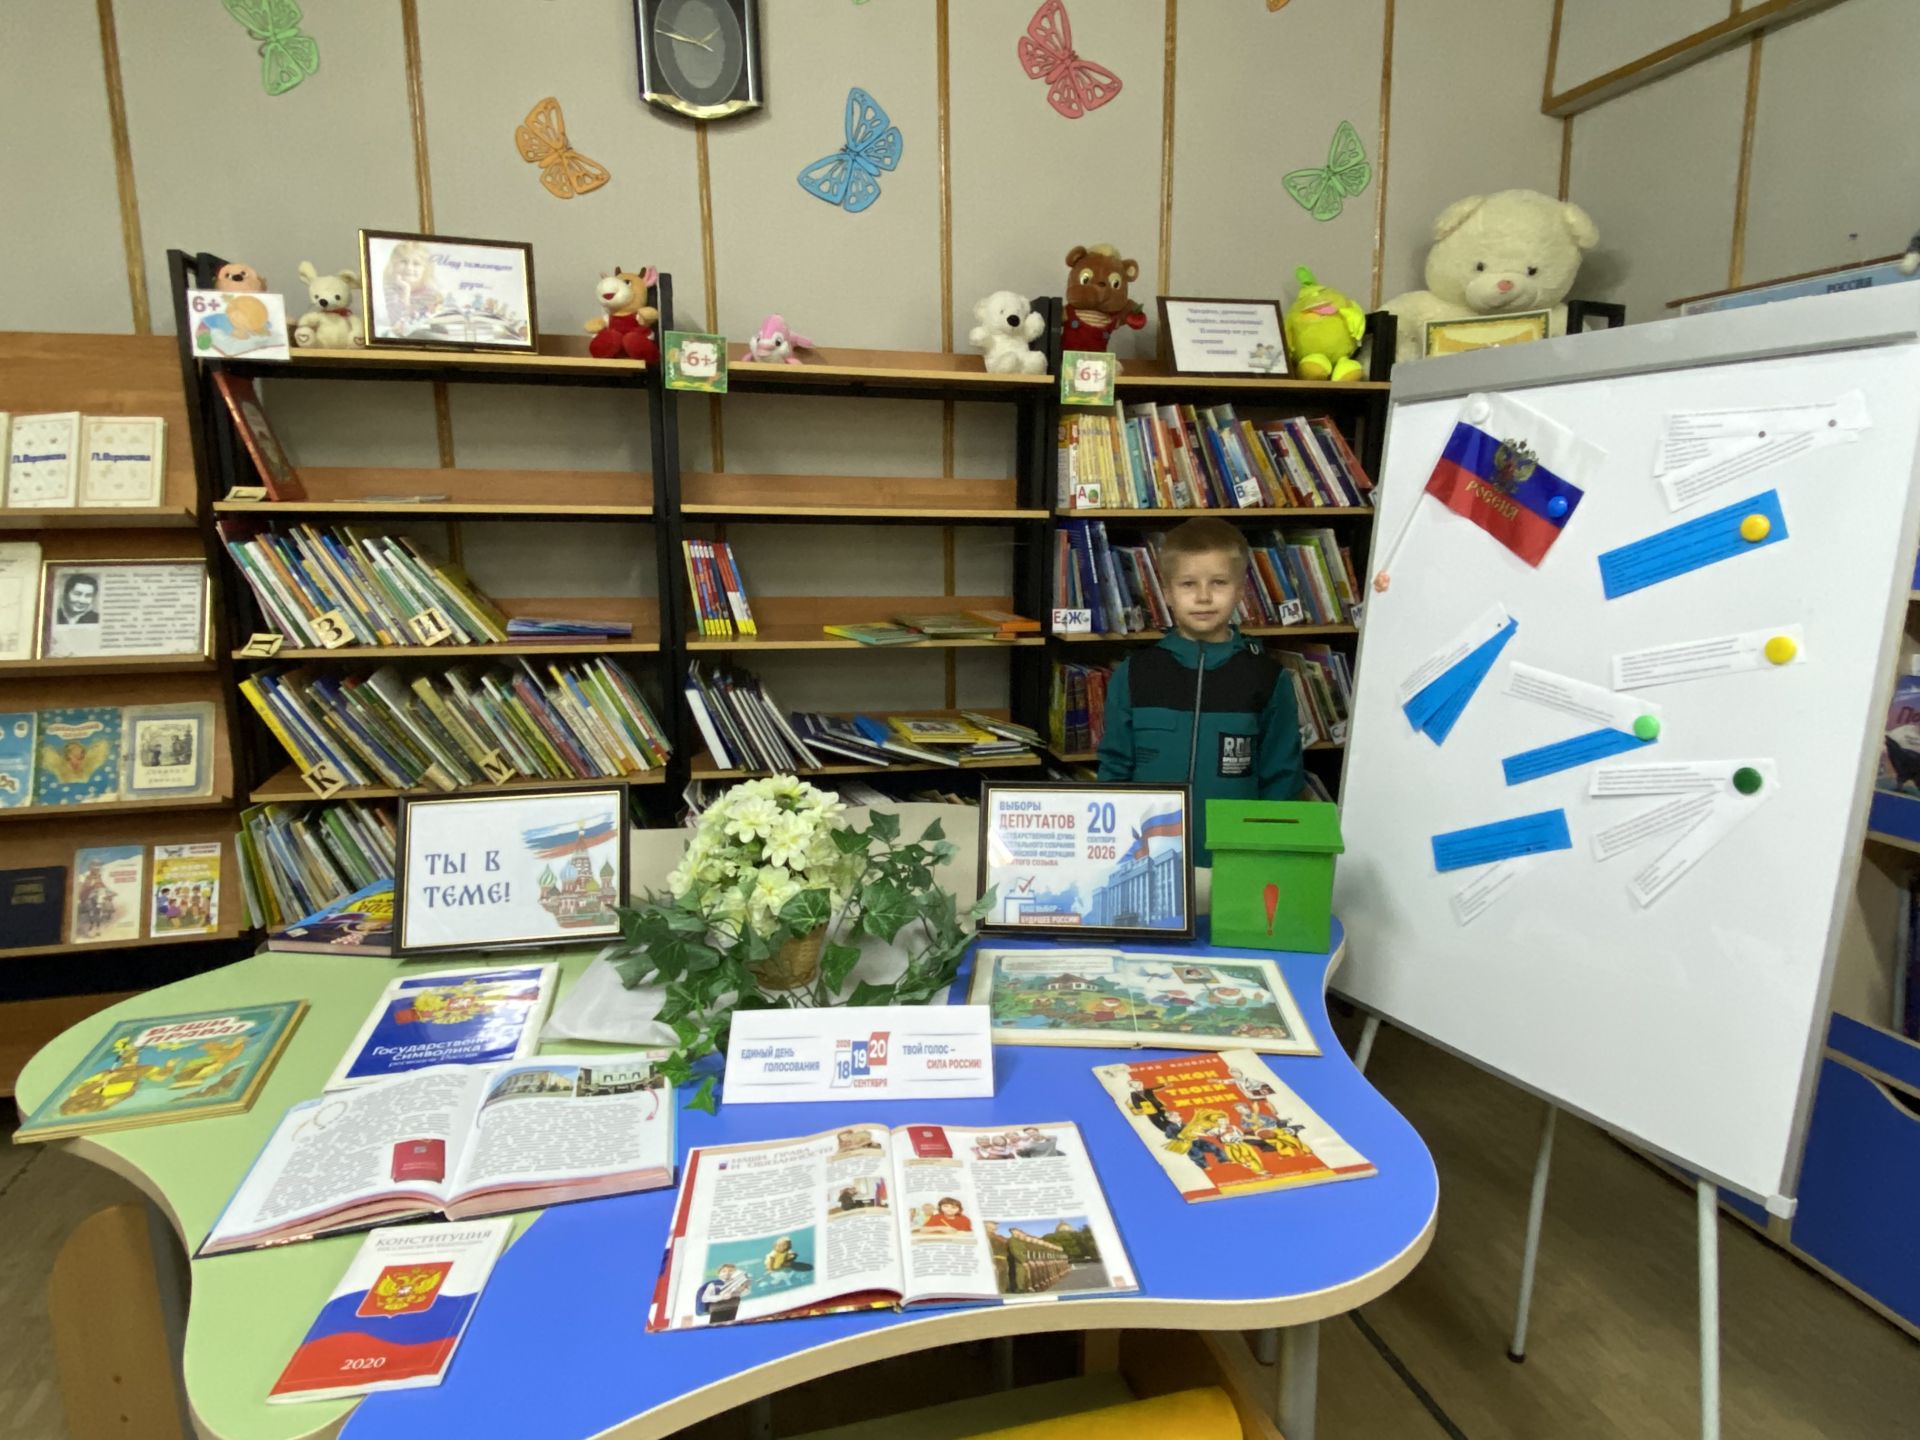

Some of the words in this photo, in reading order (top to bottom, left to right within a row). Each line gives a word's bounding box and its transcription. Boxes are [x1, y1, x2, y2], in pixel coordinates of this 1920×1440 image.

[192, 295, 221, 313] 6+
[686, 350, 712, 367] 6+
[1080, 366, 1102, 382] 6+
[1464, 479, 1520, 522] РОССИЯ
[484, 753, 515, 780] М
[308, 765, 340, 793] К
[999, 801, 1042, 812] ВЫБОРЫ
[1087, 802, 1117, 833] 20
[999, 814, 1076, 829] ДЕПУТАТОВ
[1087, 845, 1117, 860] 2026
[424, 852, 466, 876] ТЫ
[485, 850, 501, 872] В
[423, 881, 511, 909] ТЕМЕ!
[740, 1046, 773, 1060] ЕДИНЫЙ
[774, 1048, 795, 1059] ДЕНЬ
[902, 1043, 923, 1056] ТВОЙ
[923, 1045, 949, 1055] ГОЛОС
[837, 1060, 851, 1079] 18
[853, 1049, 867, 1069] 19
[869, 1039, 887, 1058] 20
[926, 1058, 947, 1070] СИЛА
[948, 1058, 982, 1070] РОССИИ!
[764, 1061, 821, 1073] ГОЛОСОВАНИЯ
[853, 1078, 888, 1088] СЕНТЯБРЯ
[1155, 1070, 1219, 1084] ЗАКОН
[1165, 1083, 1227, 1097] ТВОЕЙ
[1173, 1093, 1239, 1107] ЖИЗНИ
[375, 1230, 493, 1248] КОНСТИТУЦИЯ
[339, 1356, 387, 1371] 2020
